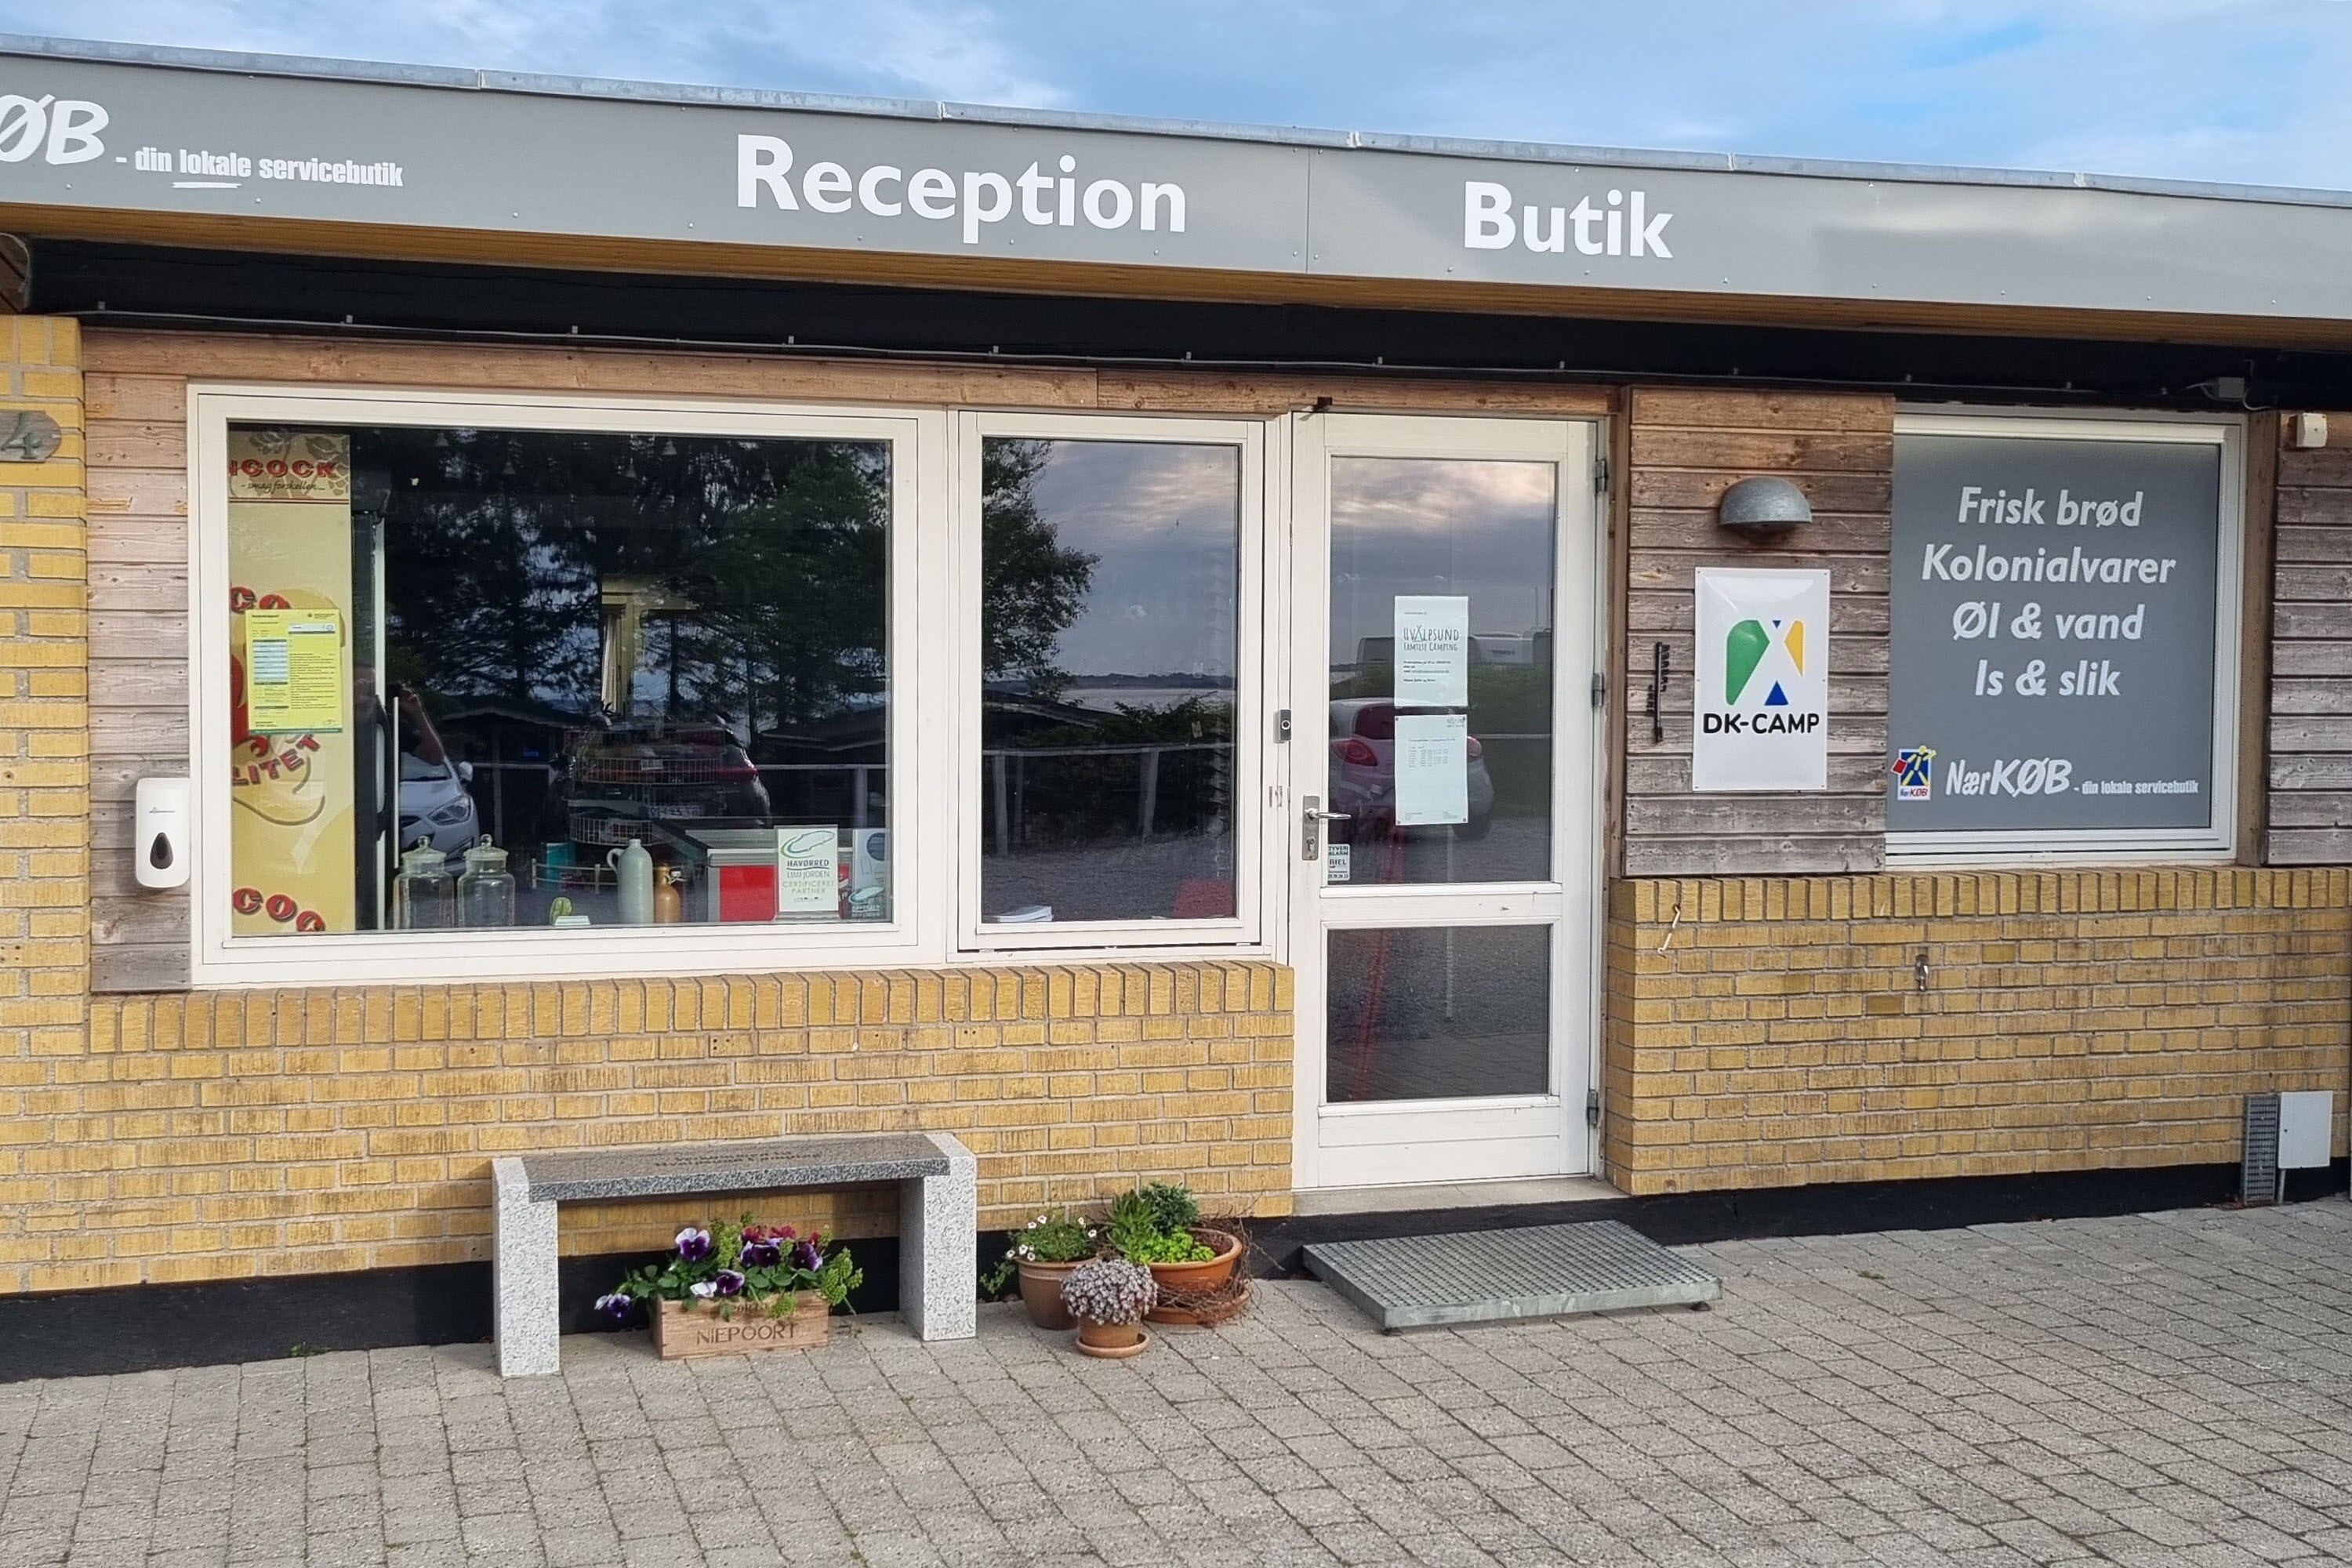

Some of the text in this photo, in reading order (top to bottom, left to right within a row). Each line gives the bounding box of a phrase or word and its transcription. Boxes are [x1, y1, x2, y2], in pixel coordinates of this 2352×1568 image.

[136, 147, 172, 172] din
[180, 150, 251, 177] lokale
[259, 158, 403, 186] servicebutik
[739, 135, 1185, 244] Reception
[1465, 181, 1673, 260] Butik
[1959, 487, 2143, 528] Frisk brød
[1922, 543, 2176, 583] Kolonialvarer
[1952, 601, 2145, 641] Øl & vand
[1976, 659, 2121, 696] Is & slik
[1704, 713, 1819, 734] DK-CAMP
[1945, 757, 2072, 798] NærKØB
[2082, 781, 2098, 794] din
[2101, 781, 2132, 794] lokale
[2135, 780, 2198, 794] servicebutik
[696, 1322, 796, 1345] NIEPOORT
